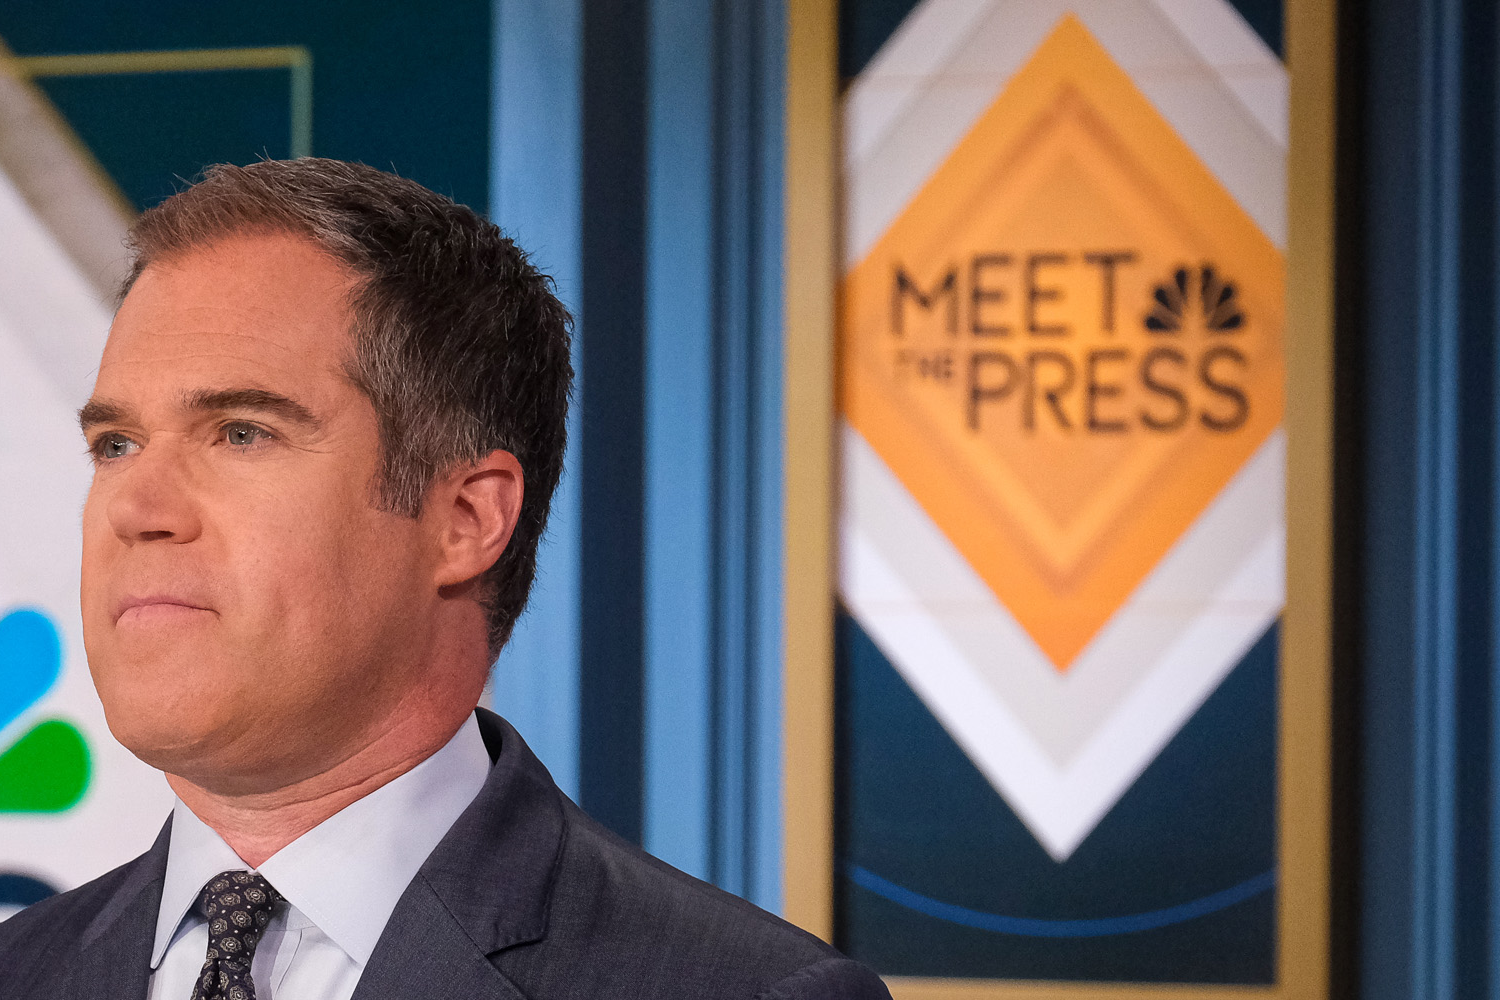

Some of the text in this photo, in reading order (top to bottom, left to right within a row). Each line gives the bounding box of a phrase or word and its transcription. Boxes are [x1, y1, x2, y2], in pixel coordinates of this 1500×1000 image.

[890, 250, 1138, 338] MEET
[899, 344, 1252, 434] THE PRESS
